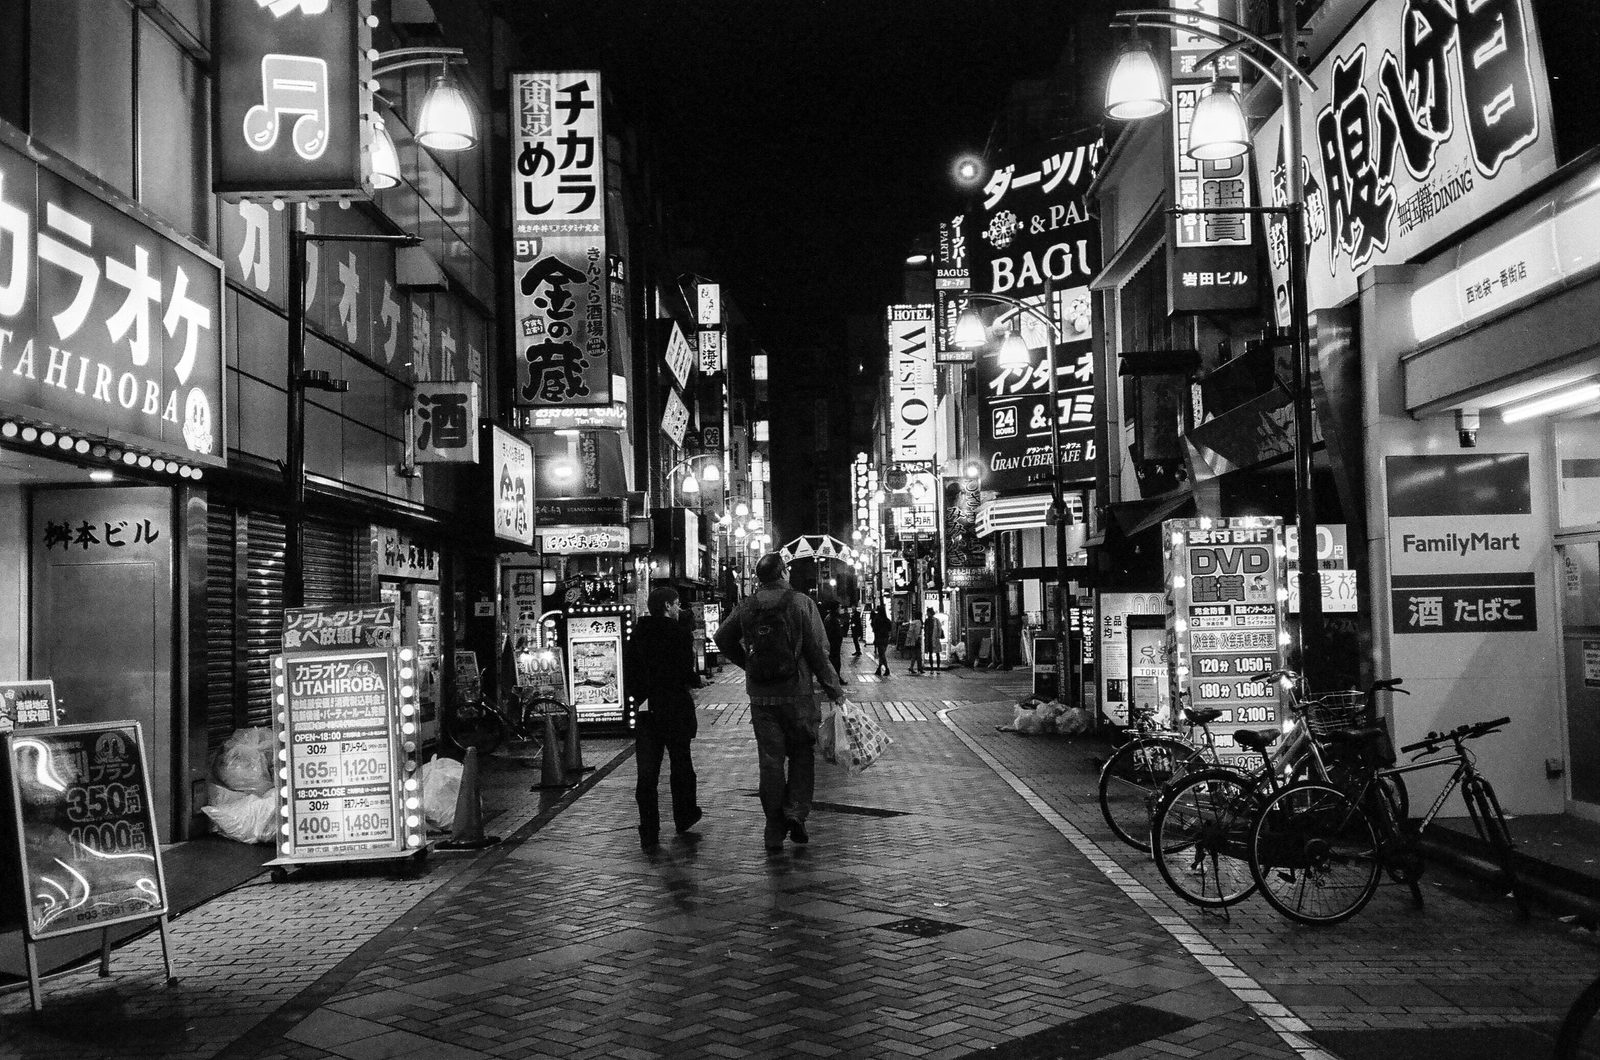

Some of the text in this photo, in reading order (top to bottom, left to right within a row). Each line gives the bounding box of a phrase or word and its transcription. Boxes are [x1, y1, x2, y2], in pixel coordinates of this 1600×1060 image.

[523, 80, 550, 135] 東京
[555, 80, 596, 214] チカラ
[518, 141, 556, 215] めし
[1433, 169, 1474, 214] DINING
[1030, 201, 1090, 234] & PA
[516, 240, 538, 256] B1
[940, 231, 949, 263] PARTY
[937, 269, 970, 277] BAGUS
[1182, 271, 1248, 287] 岩田ビル
[1465, 261, 1528, 303] 西池袋一番街店
[893, 310, 931, 320] HOTEL
[418, 394, 469, 451] 酒
[996, 409, 1015, 428] 24
[1060, 450, 1081, 463] AFE
[1402, 532, 1521, 557] FamilyMart
[1190, 546, 1270, 575] DVD
[287, 608, 391, 629] ソフトクリーム
[1408, 596, 1524, 627] 酒 たばこ
[296, 662, 350, 681] カラオケ
[1200, 657, 1230, 673] 120分
[292, 677, 385, 697] UTAHIROBA
[1200, 683, 1231, 699] 180分
[1237, 706, 1275, 722] 2,100円
[306, 744, 327, 754] 30分
[298, 757, 387, 779] 165円 1,120円
[308, 800, 330, 811] 30分
[299, 816, 341, 834] 400円
[345, 812, 389, 832] 1,480円
